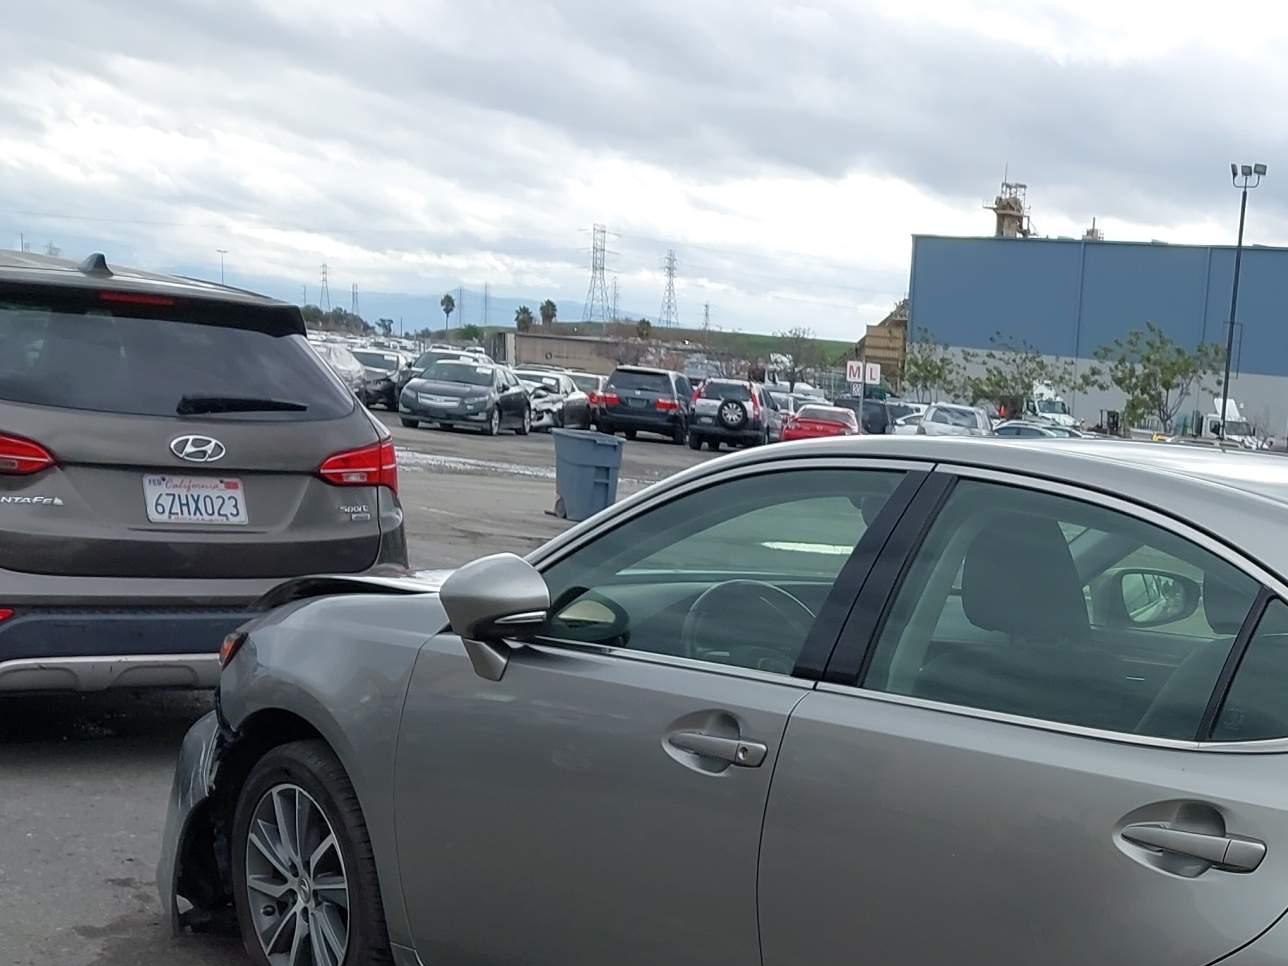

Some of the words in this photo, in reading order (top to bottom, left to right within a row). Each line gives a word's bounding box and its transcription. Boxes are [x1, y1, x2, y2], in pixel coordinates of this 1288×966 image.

[849, 365, 861, 379] M
[165, 479, 220, 493] California
[154, 493, 240, 519] 6ZHX023
